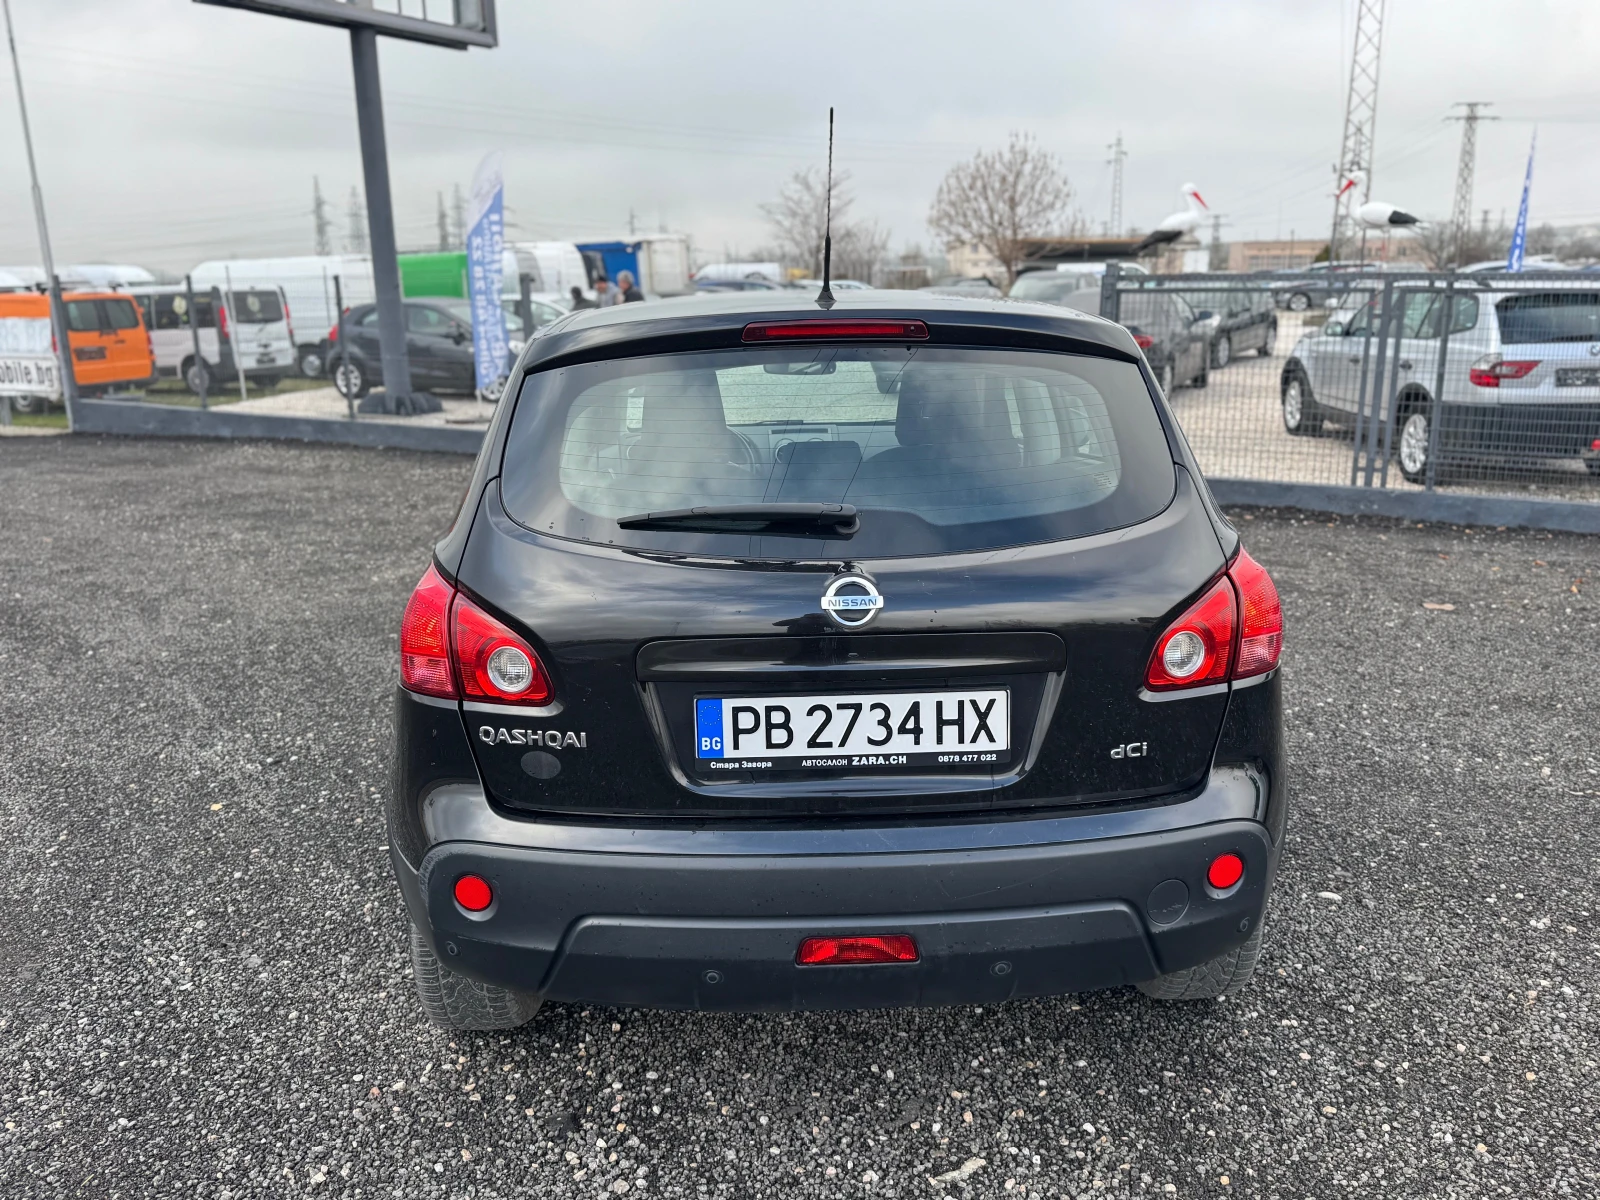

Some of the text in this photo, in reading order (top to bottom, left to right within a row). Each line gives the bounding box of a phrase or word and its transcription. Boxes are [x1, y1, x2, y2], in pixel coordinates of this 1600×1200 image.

[828, 598, 877, 607] NISSAN
[701, 698, 997, 751] BG PB 2734 HX
[479, 725, 588, 750] QASHQAI
[1110, 741, 1148, 760] dCi
[710, 761, 740, 769] Стара
[801, 758, 848, 767] АВТОСАЛОН
[851, 755, 907, 766] ZARA.CH
[937, 755, 960, 763] 0878
[961, 754, 979, 762] 477
[980, 753, 997, 761] 022
